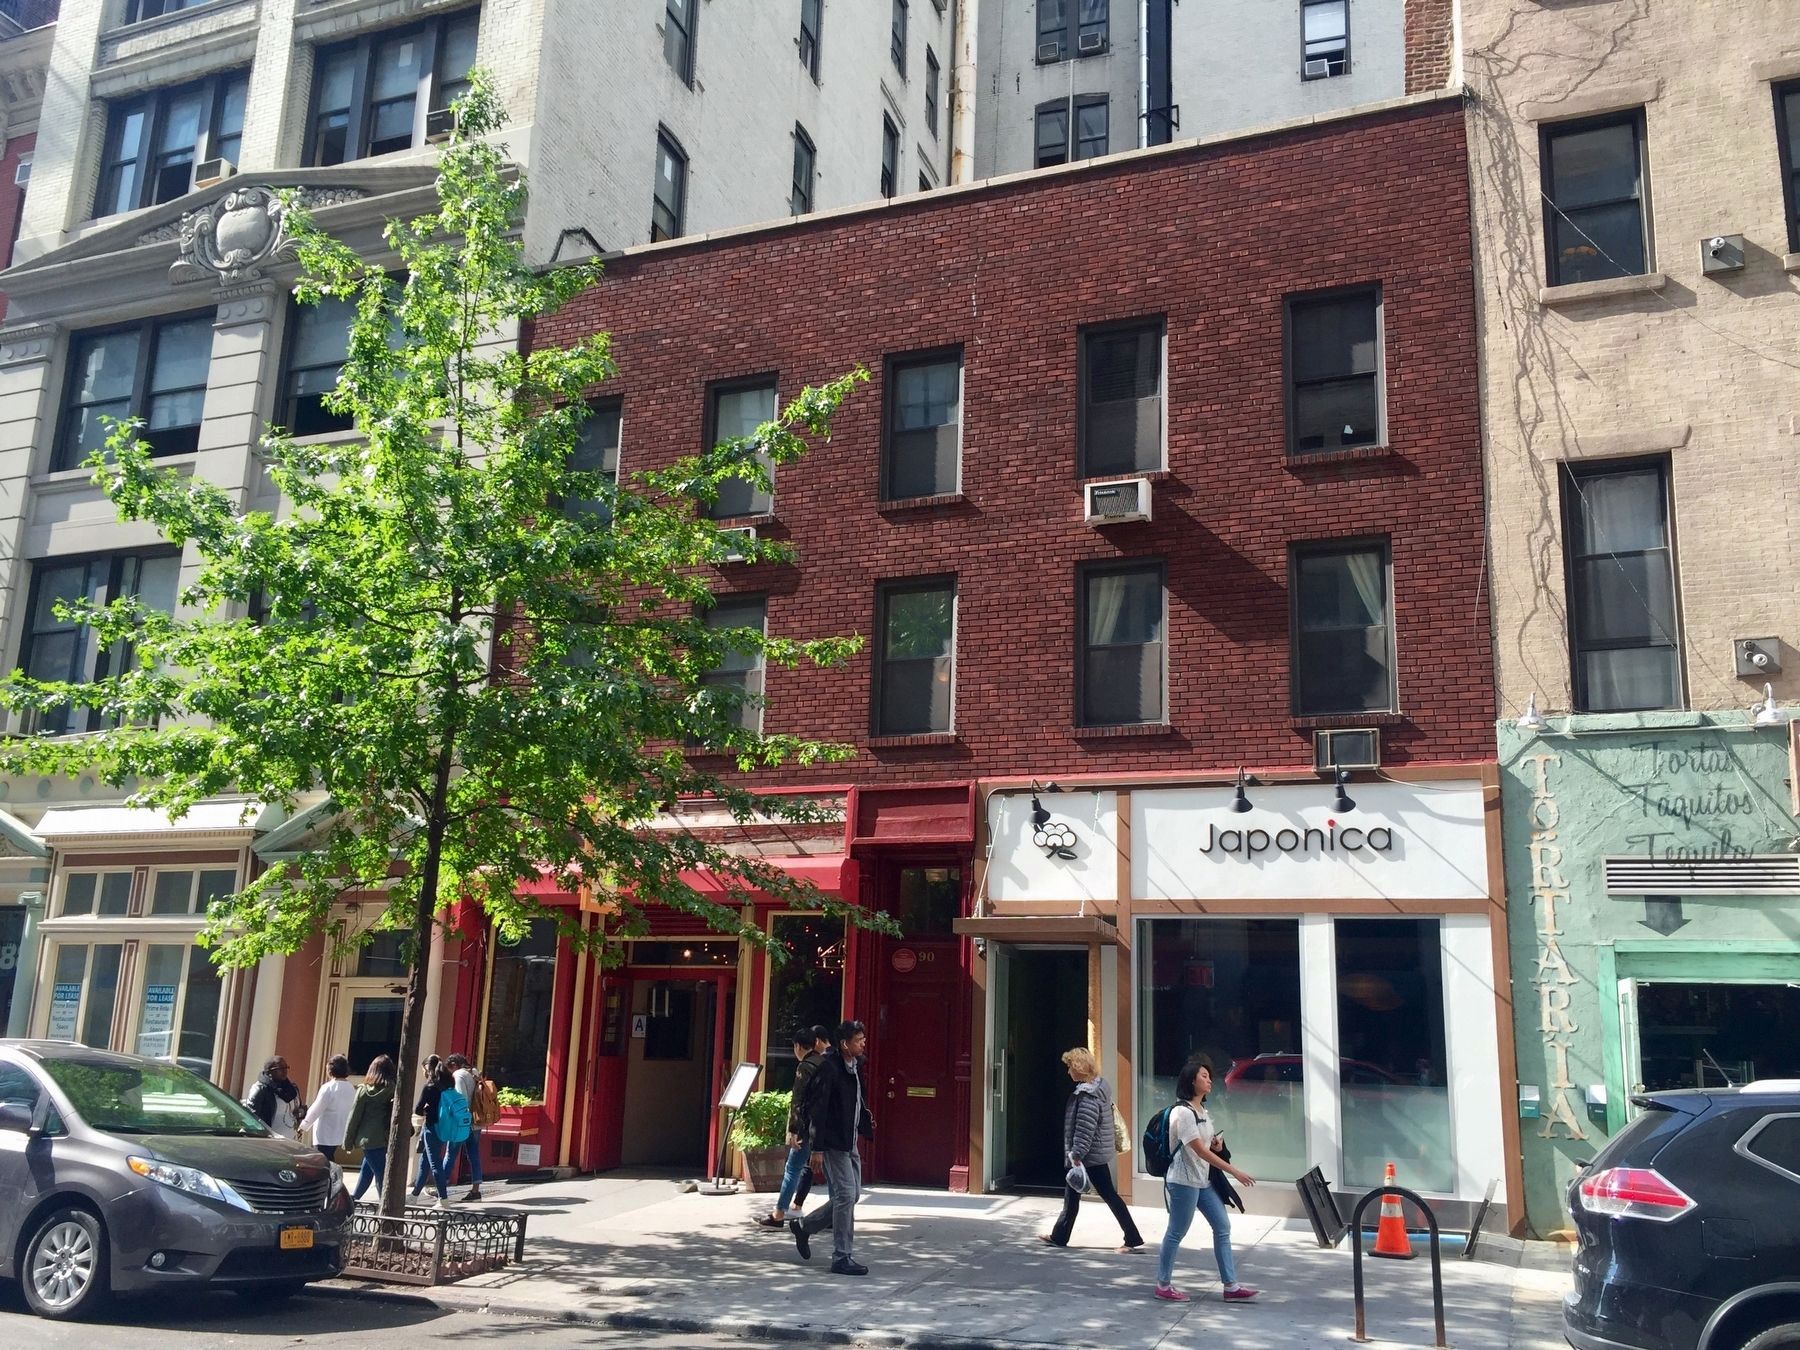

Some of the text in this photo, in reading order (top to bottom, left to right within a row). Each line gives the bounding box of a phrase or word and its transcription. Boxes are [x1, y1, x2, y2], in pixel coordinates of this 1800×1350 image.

[1629, 739, 1735, 779] Tortas
[1621, 781, 1753, 831] Taquitos
[1199, 818, 1392, 860] Japonica
[918, 951, 935, 962] 90
[635, 1017, 644, 1032] A
